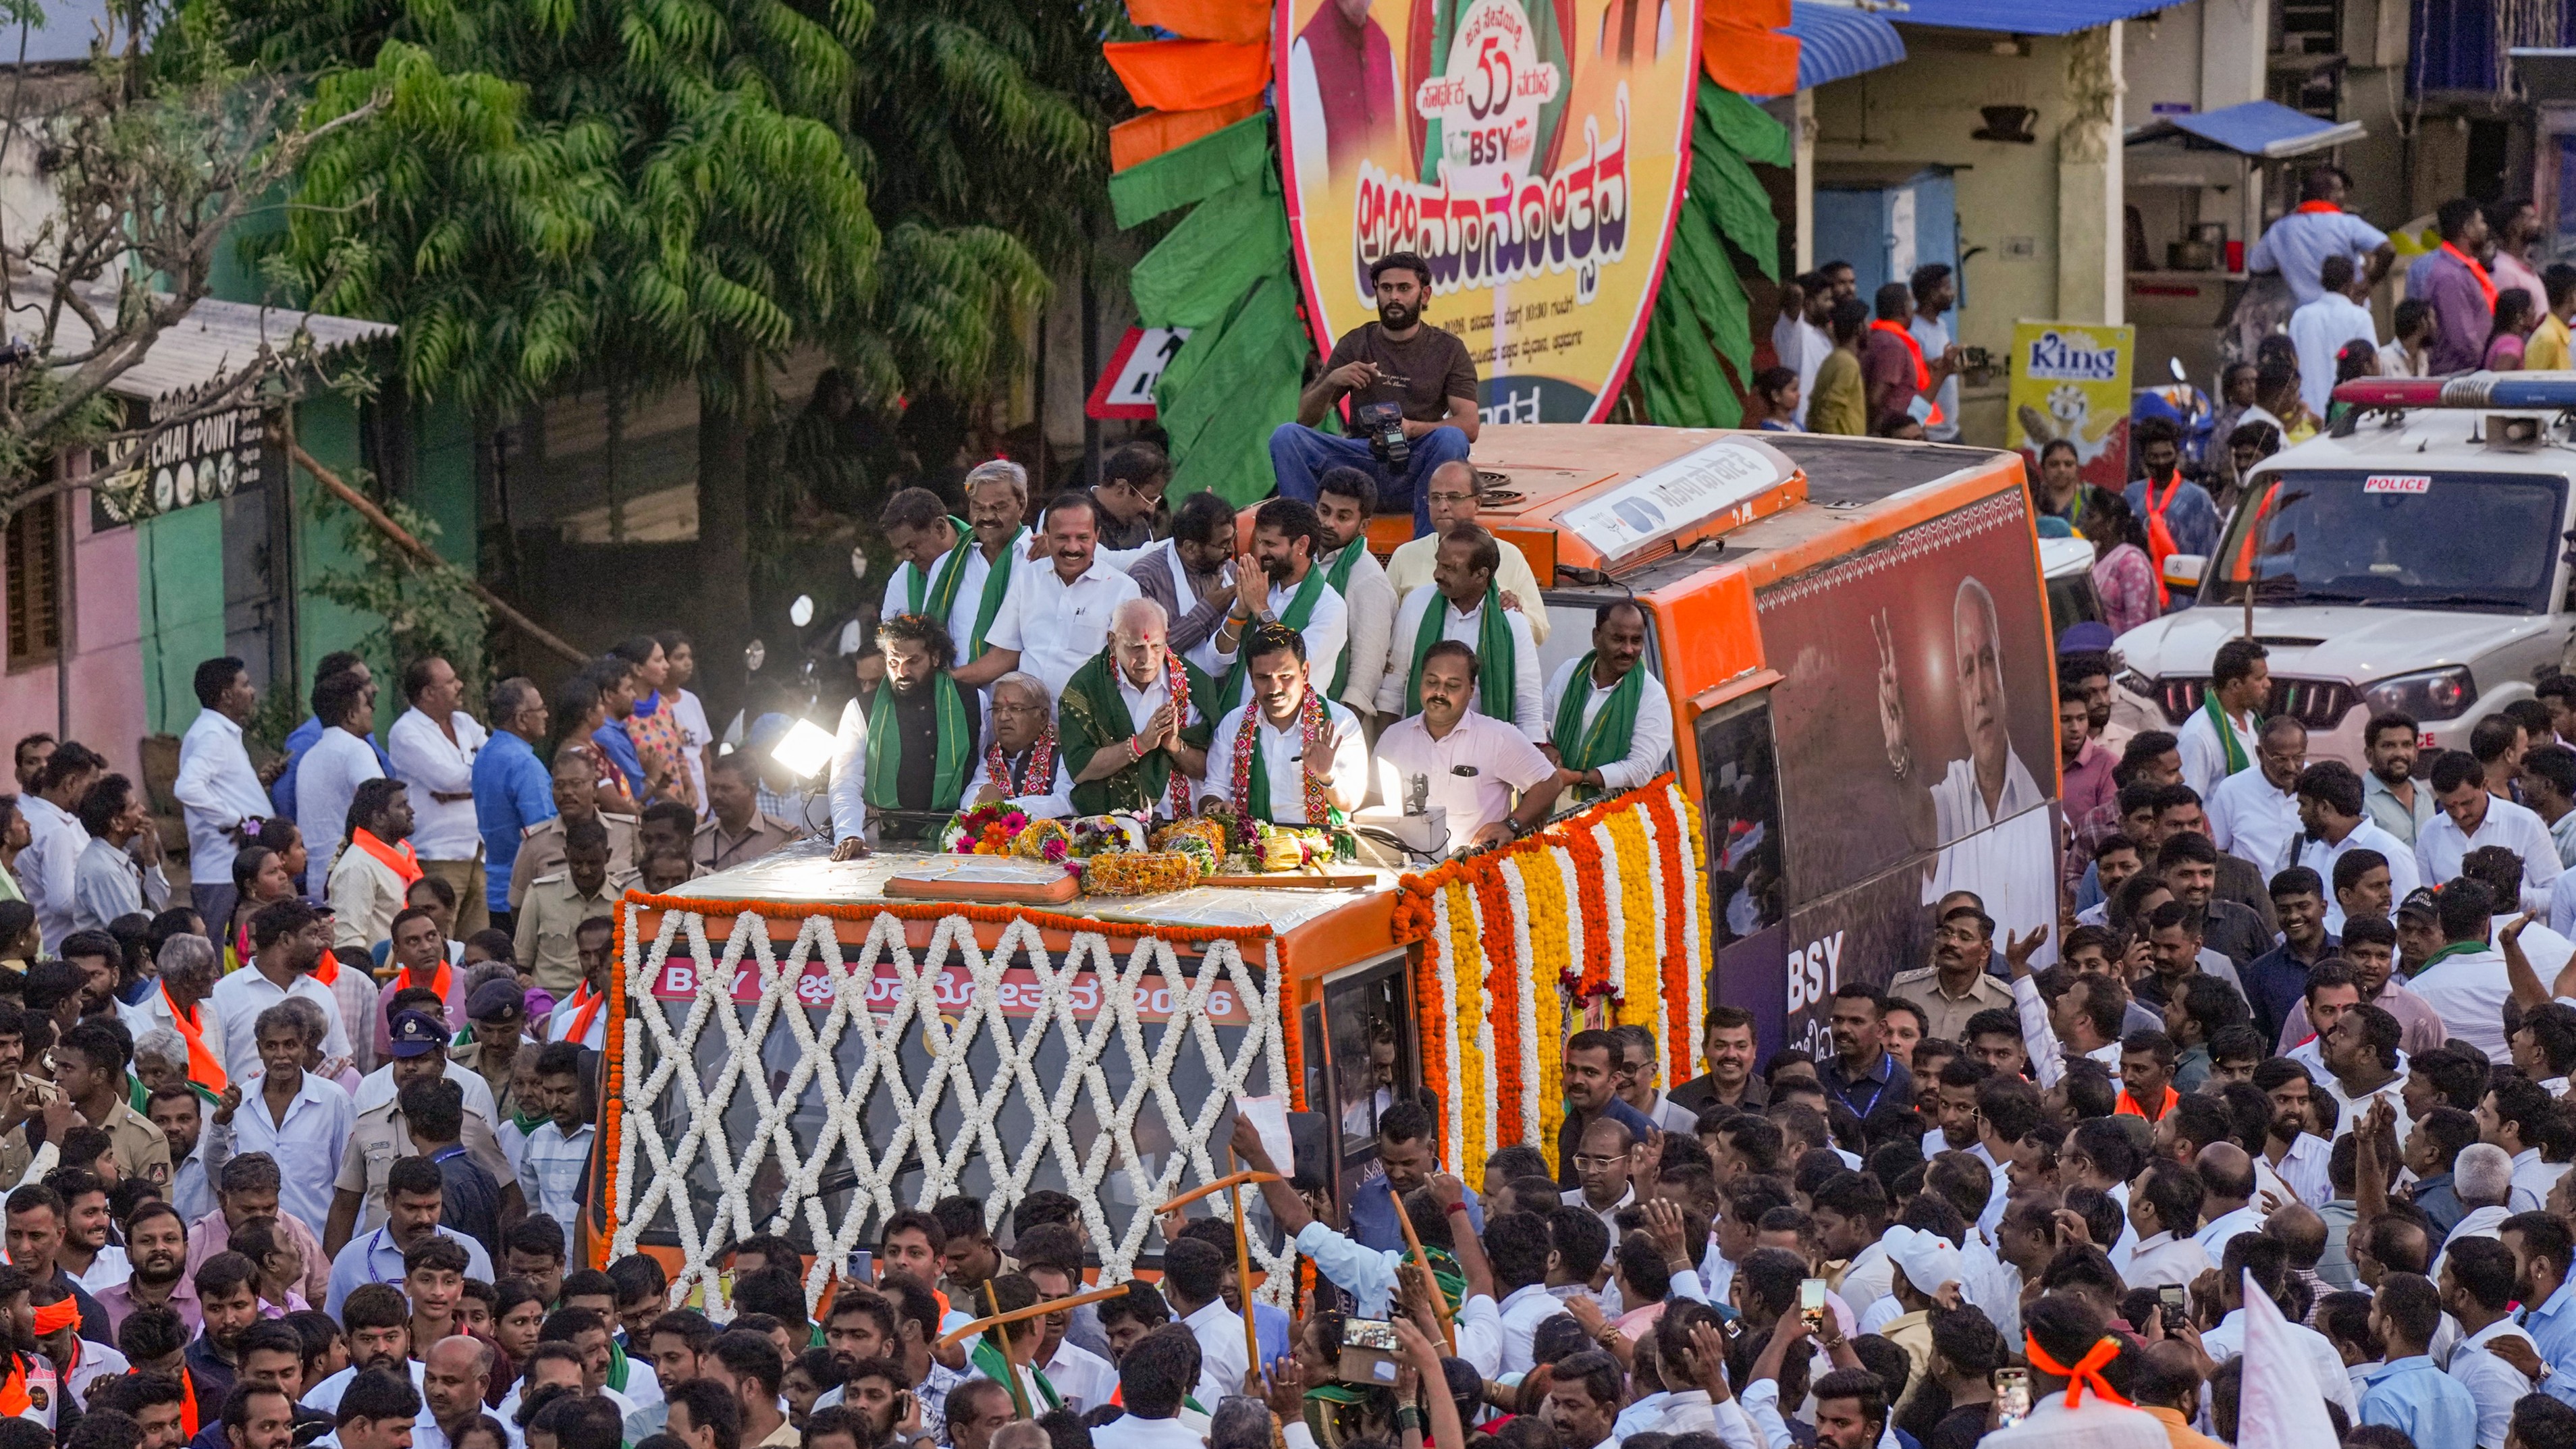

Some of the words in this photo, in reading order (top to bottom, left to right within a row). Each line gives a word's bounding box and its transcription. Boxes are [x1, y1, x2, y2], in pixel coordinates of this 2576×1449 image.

[1470, 126, 1512, 166] BSY
[2032, 333, 2116, 379] King
[151, 424, 188, 468] CHAI
[192, 409, 239, 458] POINT
[1649, 476, 1707, 507] भाजपा
[1684, 465, 1725, 489] को
[2366, 479, 2427, 491] POLICE
[666, 967, 748, 995] BY
[1135, 987, 1232, 1016] 206
[1788, 930, 1844, 1015] BSY
